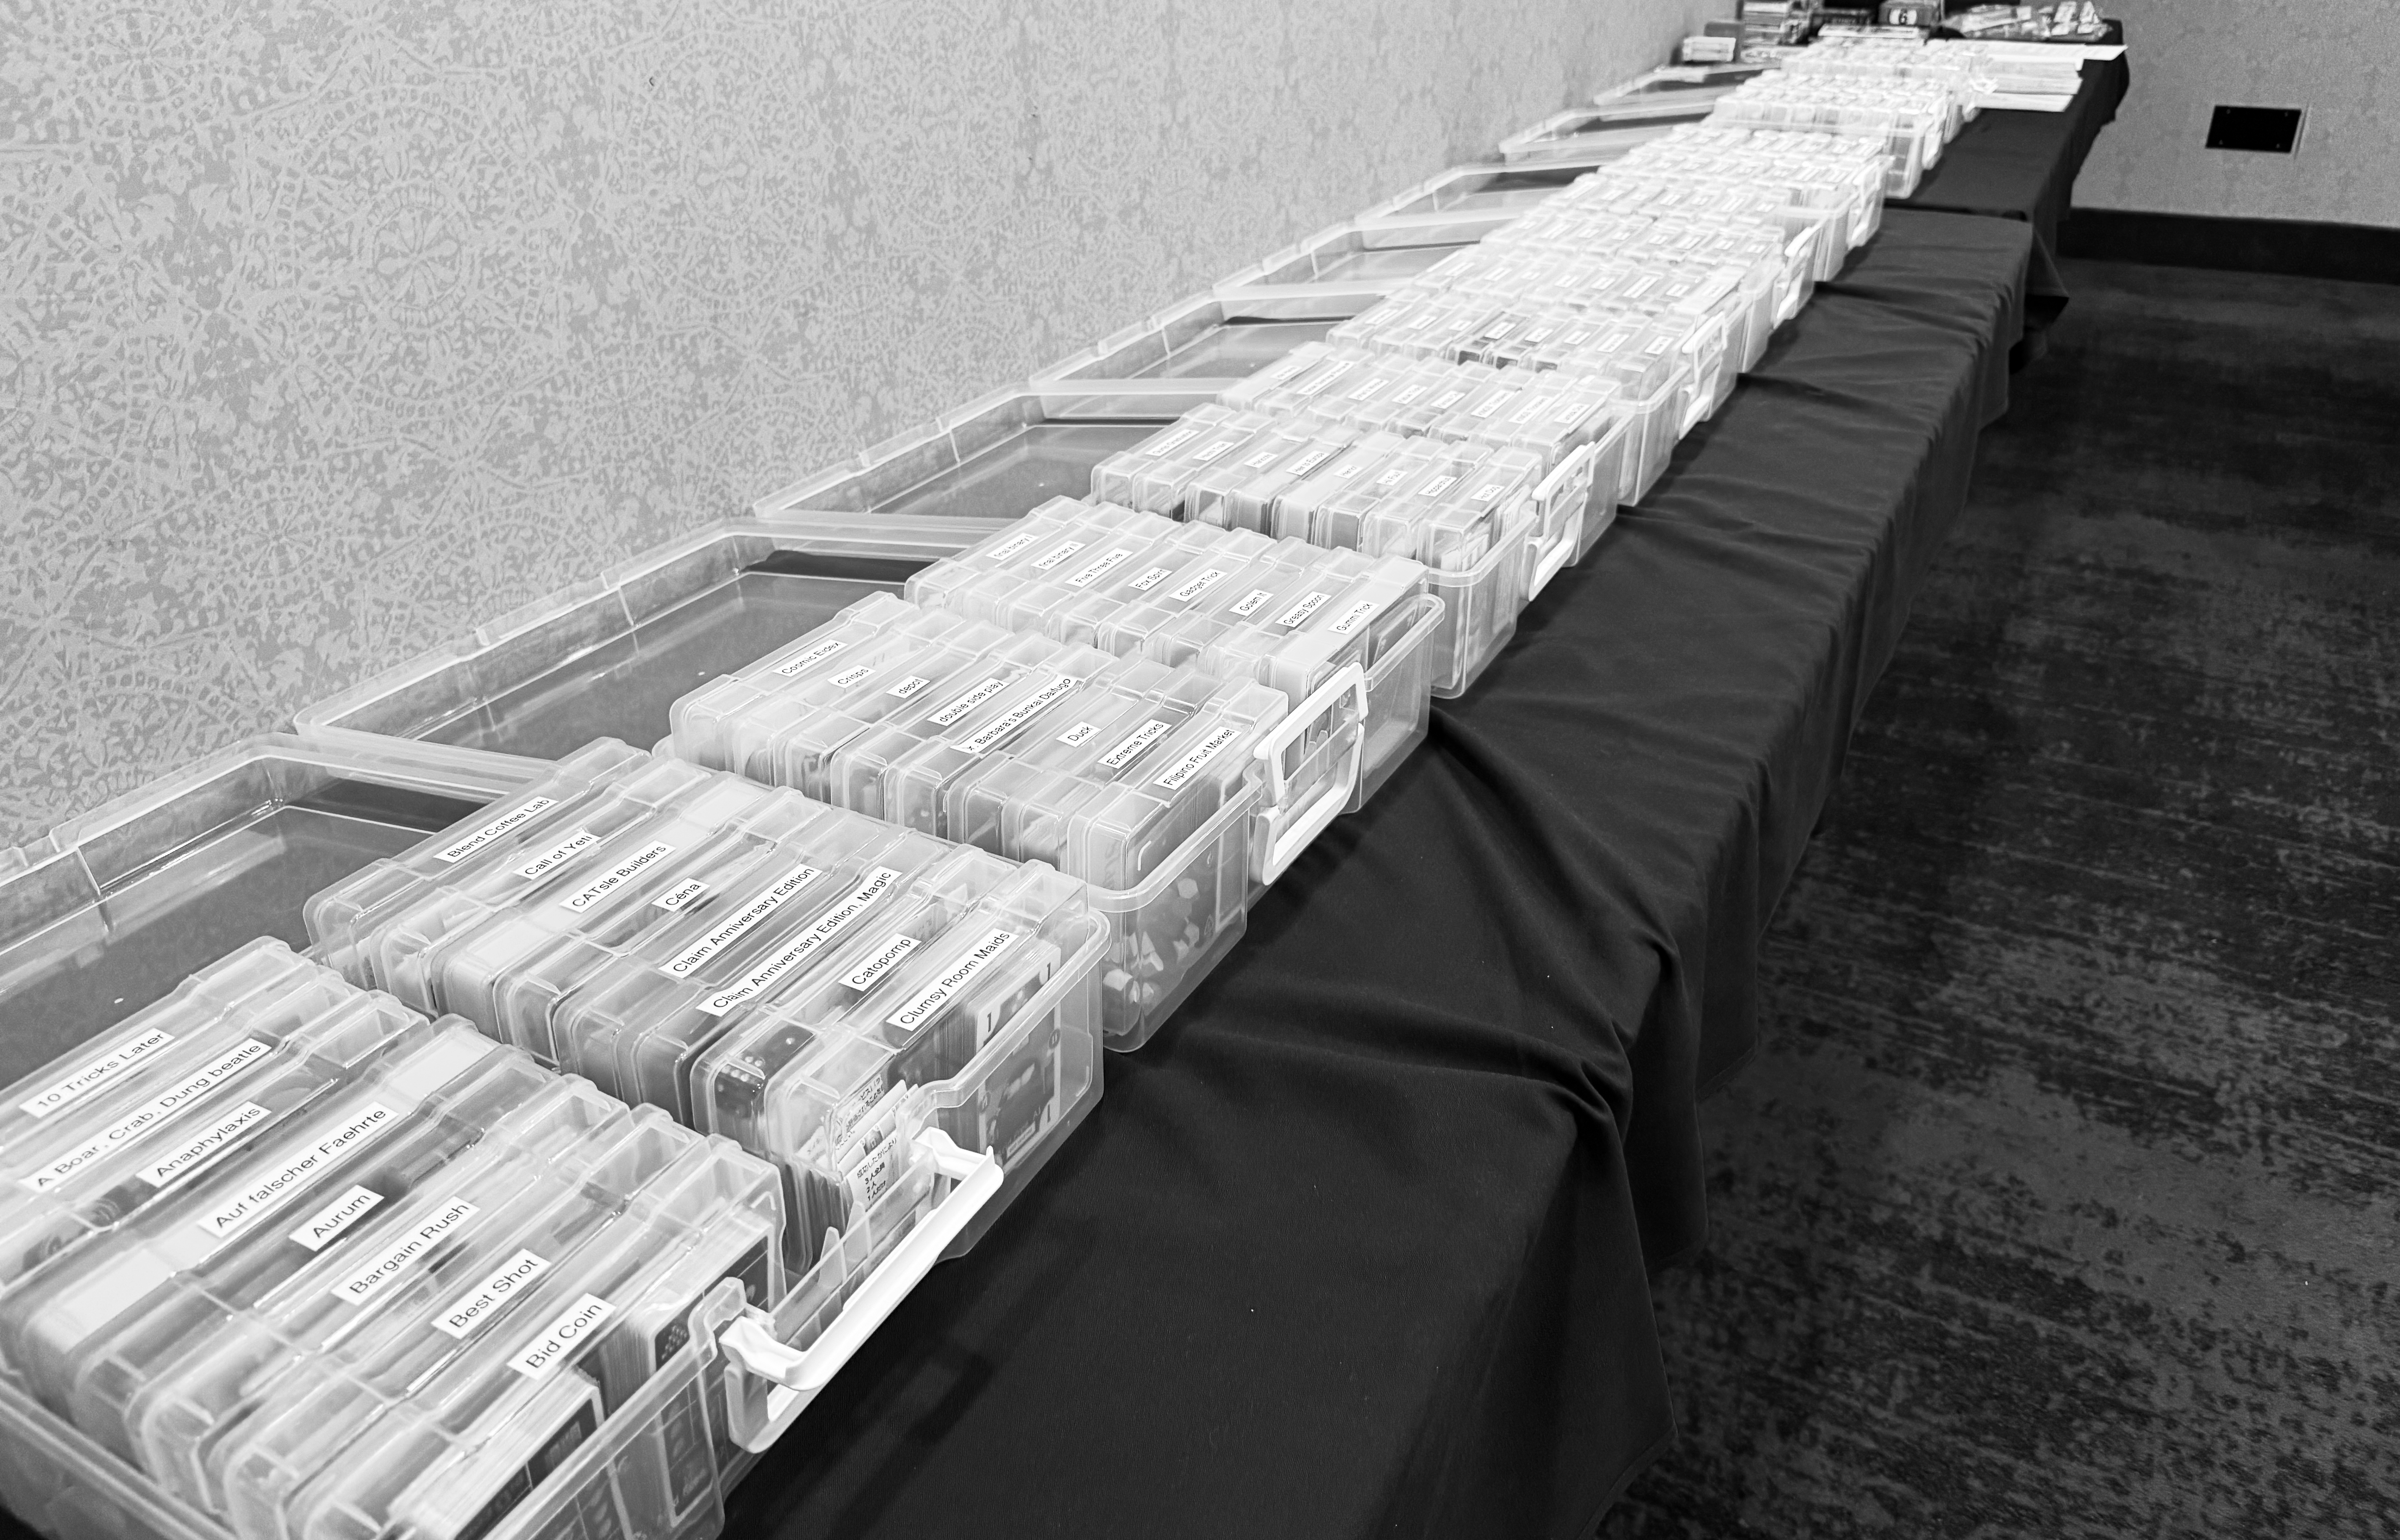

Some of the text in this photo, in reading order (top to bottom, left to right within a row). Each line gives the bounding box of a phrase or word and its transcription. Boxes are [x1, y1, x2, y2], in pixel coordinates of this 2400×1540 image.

[1076, 574, 1092, 582] Five
[1088, 562, 1110, 573] Three
[1201, 572, 1220, 581] Trick
[1284, 595, 1325, 624] Greasy Spoon
[1337, 603, 1373, 630] Gummi Trick
[782, 653, 816, 674] Cosmic
[837, 667, 868, 685] Crisps
[898, 678, 924, 694] depot
[939, 681, 1003, 723] double side play
[975, 678, 1071, 744] Barbara's Bunkai Daifugo
[1068, 726, 1094, 741] Duck
[1107, 723, 1164, 765] Extreme Tricks
[1163, 730, 1235, 785] Filipino Fruit Market
[447, 799, 549, 858] Blend Coffee Lab
[525, 835, 592, 875] Call of Yeti
[572, 845, 666, 907] CATsle Builders
[665, 883, 701, 906] Céna
[673, 867, 814, 971] Claim Anniversary Edition
[713, 872, 891, 1008] Claim Anniversary Edition, Magic
[852, 938, 911, 985] Catopomp
[900, 932, 1010, 1024] Clumsy Room Maids
[1047, 962, 1050, 981] 1
[987, 1012, 991, 1032] 1
[37, 1033, 164, 1108] 10 Tricks Later
[37, 1176, 53, 1187] A
[159, 1077, 208, 1107] Dung
[208, 1043, 261, 1077] beatle
[156, 1106, 261, 1178] Anaphylaxis
[215, 1110, 385, 1228] Auf falscher Faehrte
[313, 1194, 371, 1238] Aurum
[349, 1203, 469, 1294] Bargain Rush
[449, 1259, 538, 1328] Best Shot
[526, 1305, 603, 1369] Bid Coin
